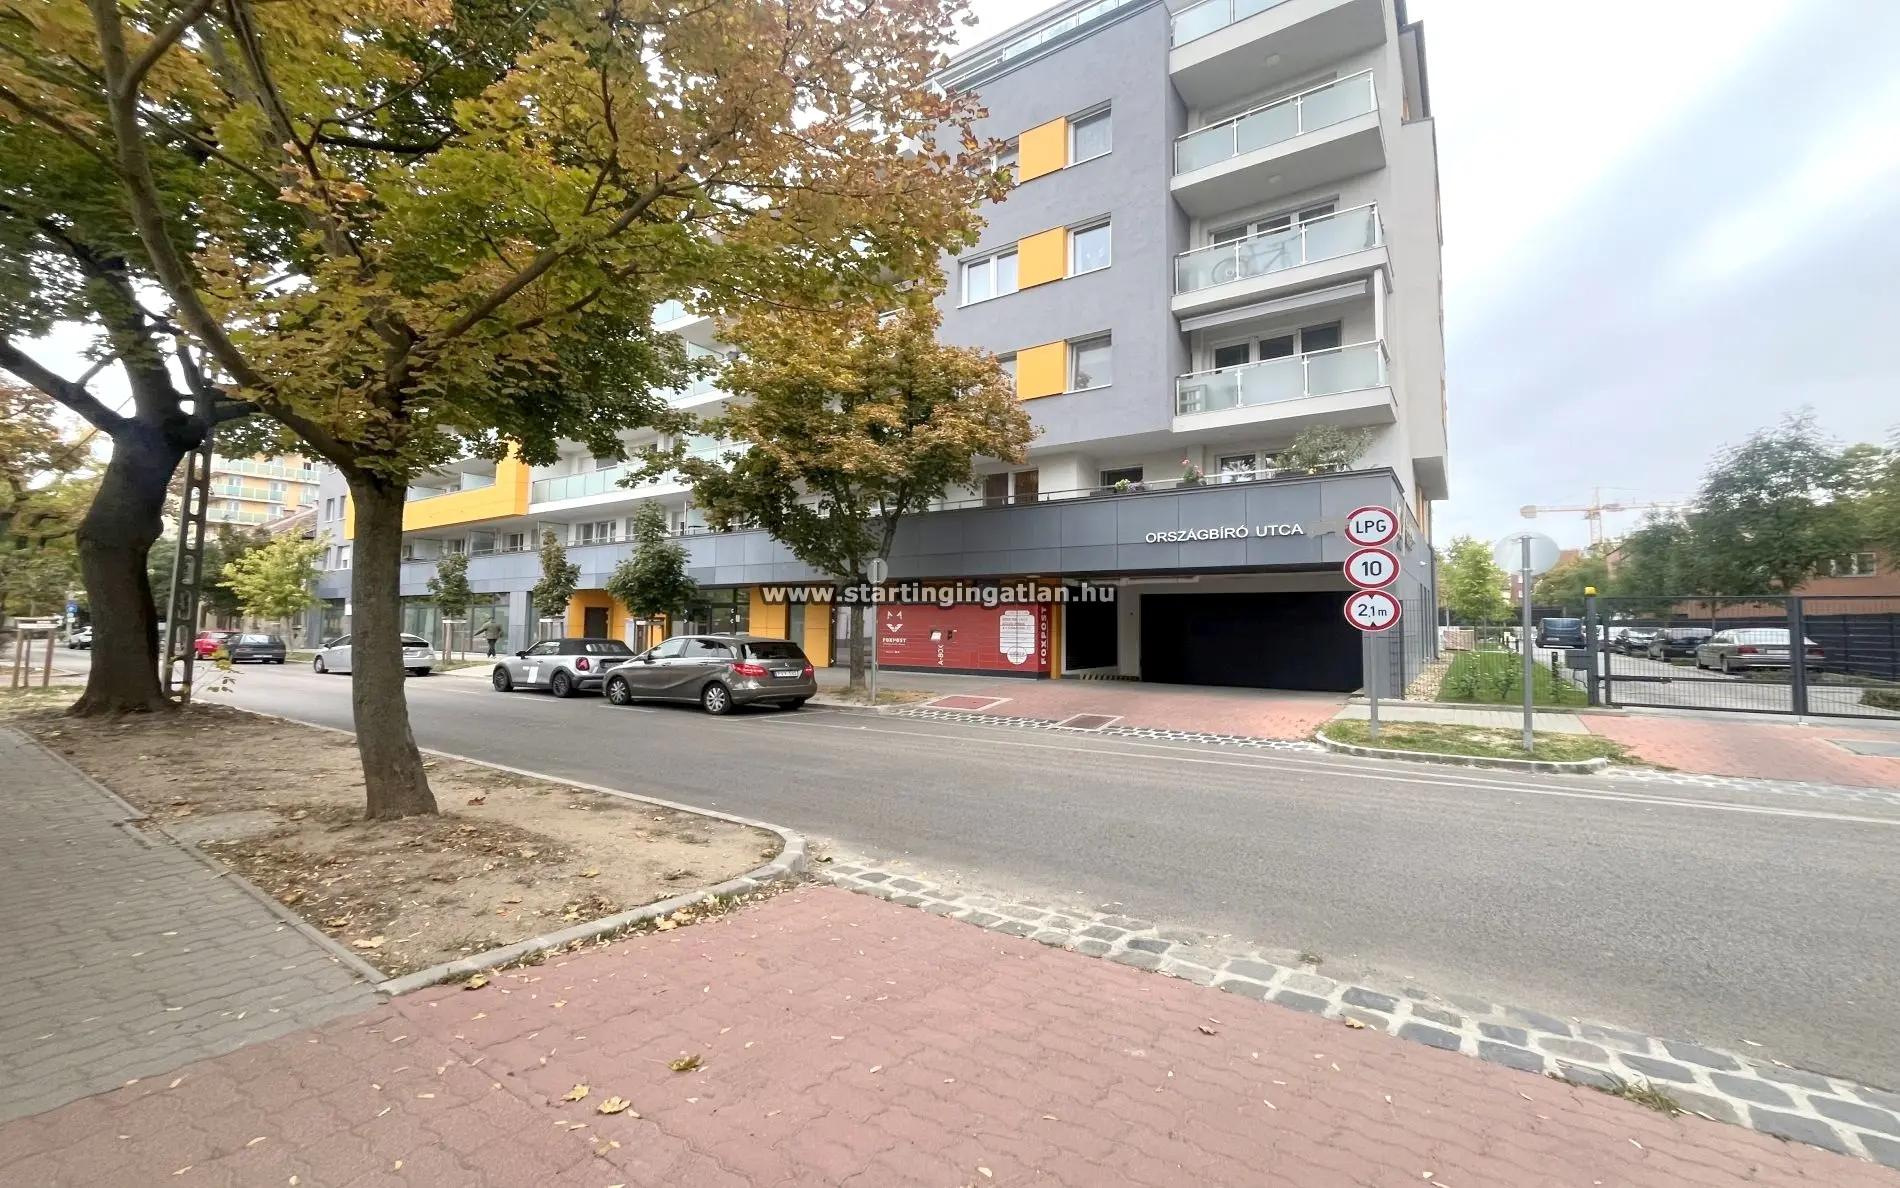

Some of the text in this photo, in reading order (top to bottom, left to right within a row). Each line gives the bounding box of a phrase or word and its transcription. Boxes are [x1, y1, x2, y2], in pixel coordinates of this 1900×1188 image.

[1145, 523, 1303, 543] ORSZÁGBÍRÓ UTCA
[1356, 519, 1387, 533] LPG
[1361, 561, 1382, 576] 10
